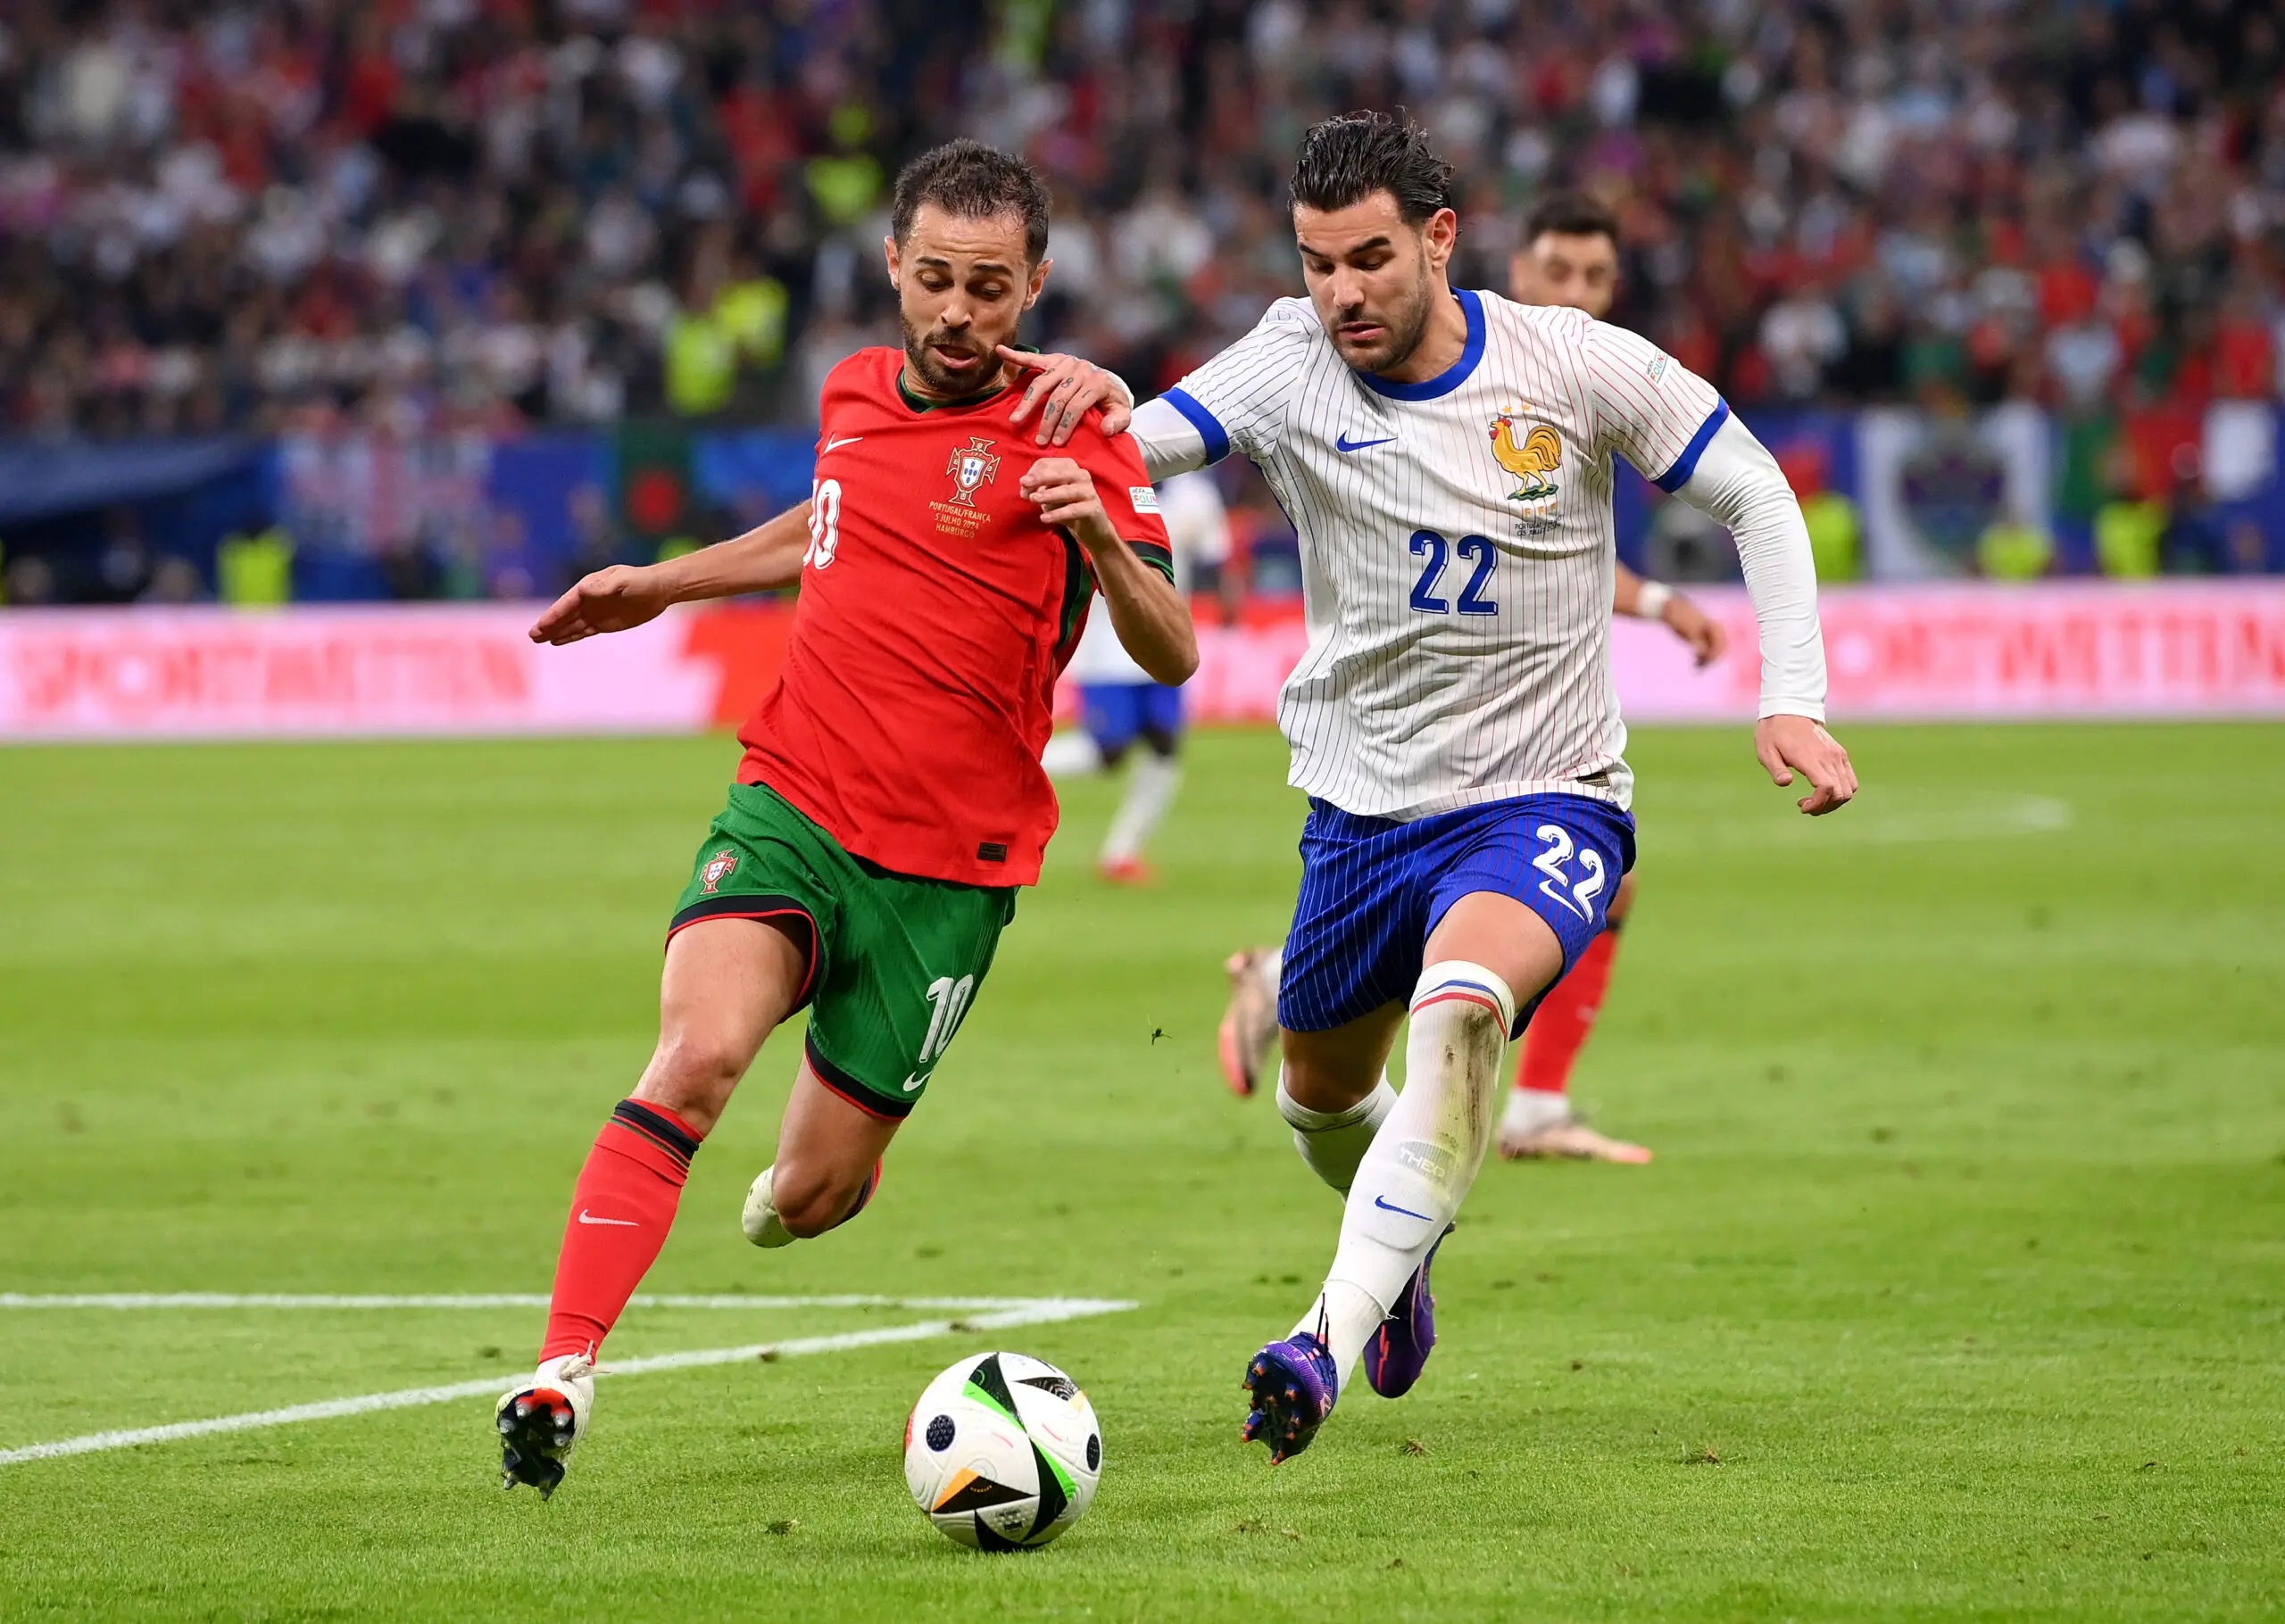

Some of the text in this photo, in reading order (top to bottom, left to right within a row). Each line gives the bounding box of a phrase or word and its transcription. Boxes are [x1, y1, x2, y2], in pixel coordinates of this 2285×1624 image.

[935, 523, 975, 538] HAMBURGO
[940, 514, 961, 526] JULHO
[963, 519, 979, 530] 2024
[1409, 529, 1499, 617] 22
[1532, 824, 1606, 925] 22
[919, 974, 974, 1064] 10
